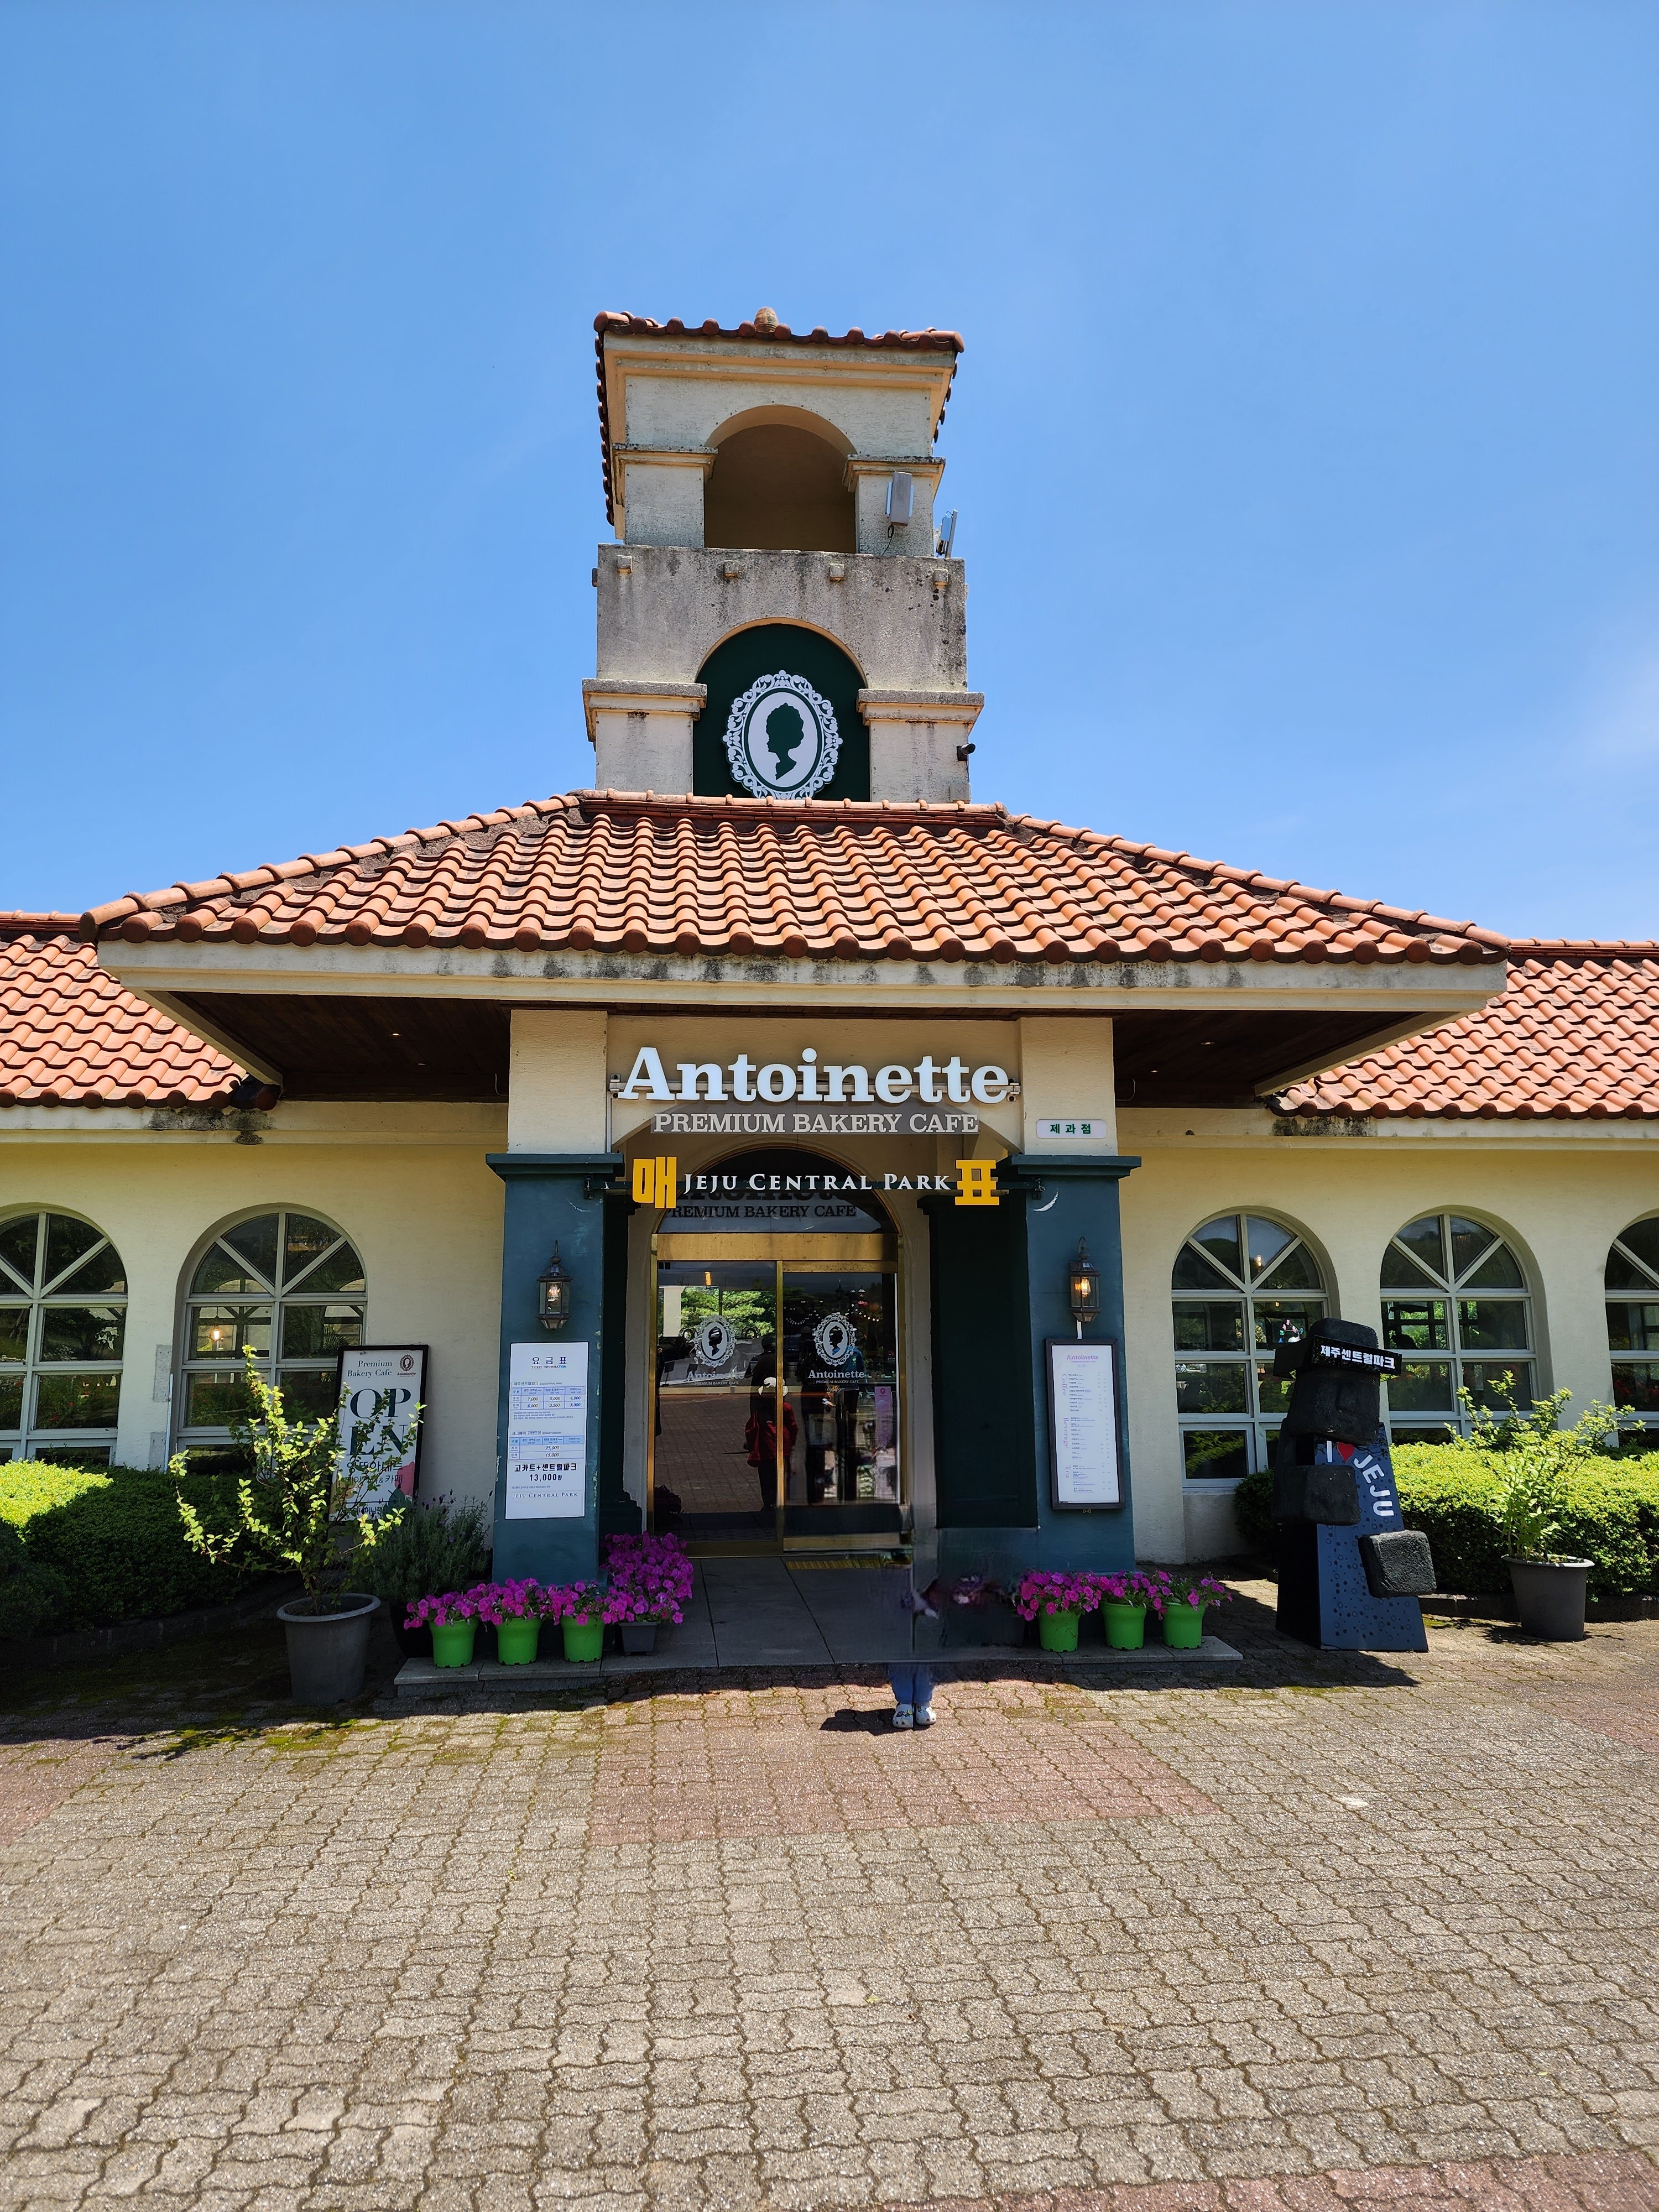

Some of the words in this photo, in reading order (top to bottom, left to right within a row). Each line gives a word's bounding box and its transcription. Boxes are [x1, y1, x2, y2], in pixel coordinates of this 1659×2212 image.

[618, 1046, 1009, 1104] Antoinette
[654, 1113, 786, 1133] PREMIUM
[792, 1114, 902, 1133] BAKERY
[909, 1113, 979, 1133] CAFE
[1050, 1123, 1092, 1134] 제과점
[632, 1156, 677, 1209] 매
[683, 1173, 738, 1194] JEJU
[749, 1173, 872, 1191] CENTRAL
[883, 1173, 951, 1190] PARK
[954, 1159, 1000, 1206] 표
[667, 1206, 740, 1217] REMIUM
[744, 1206, 810, 1217] BAKERY
[814, 1205, 856, 1217] CAFE
[531, 1357, 567, 1365] 요금표
[1321, 1345, 1395, 1369] 제주센트럴파크
[347, 1370, 372, 1378] Bakery
[808, 1369, 865, 1379] Antoinette
[514, 1463, 577, 1472] 고카트+센트럴파크
[385, 1474, 403, 1484] 카페
[530, 1473, 562, 1482] 13,000원
[1327, 1440, 1333, 1463] I
[1354, 1454, 1395, 1516] JEJU
